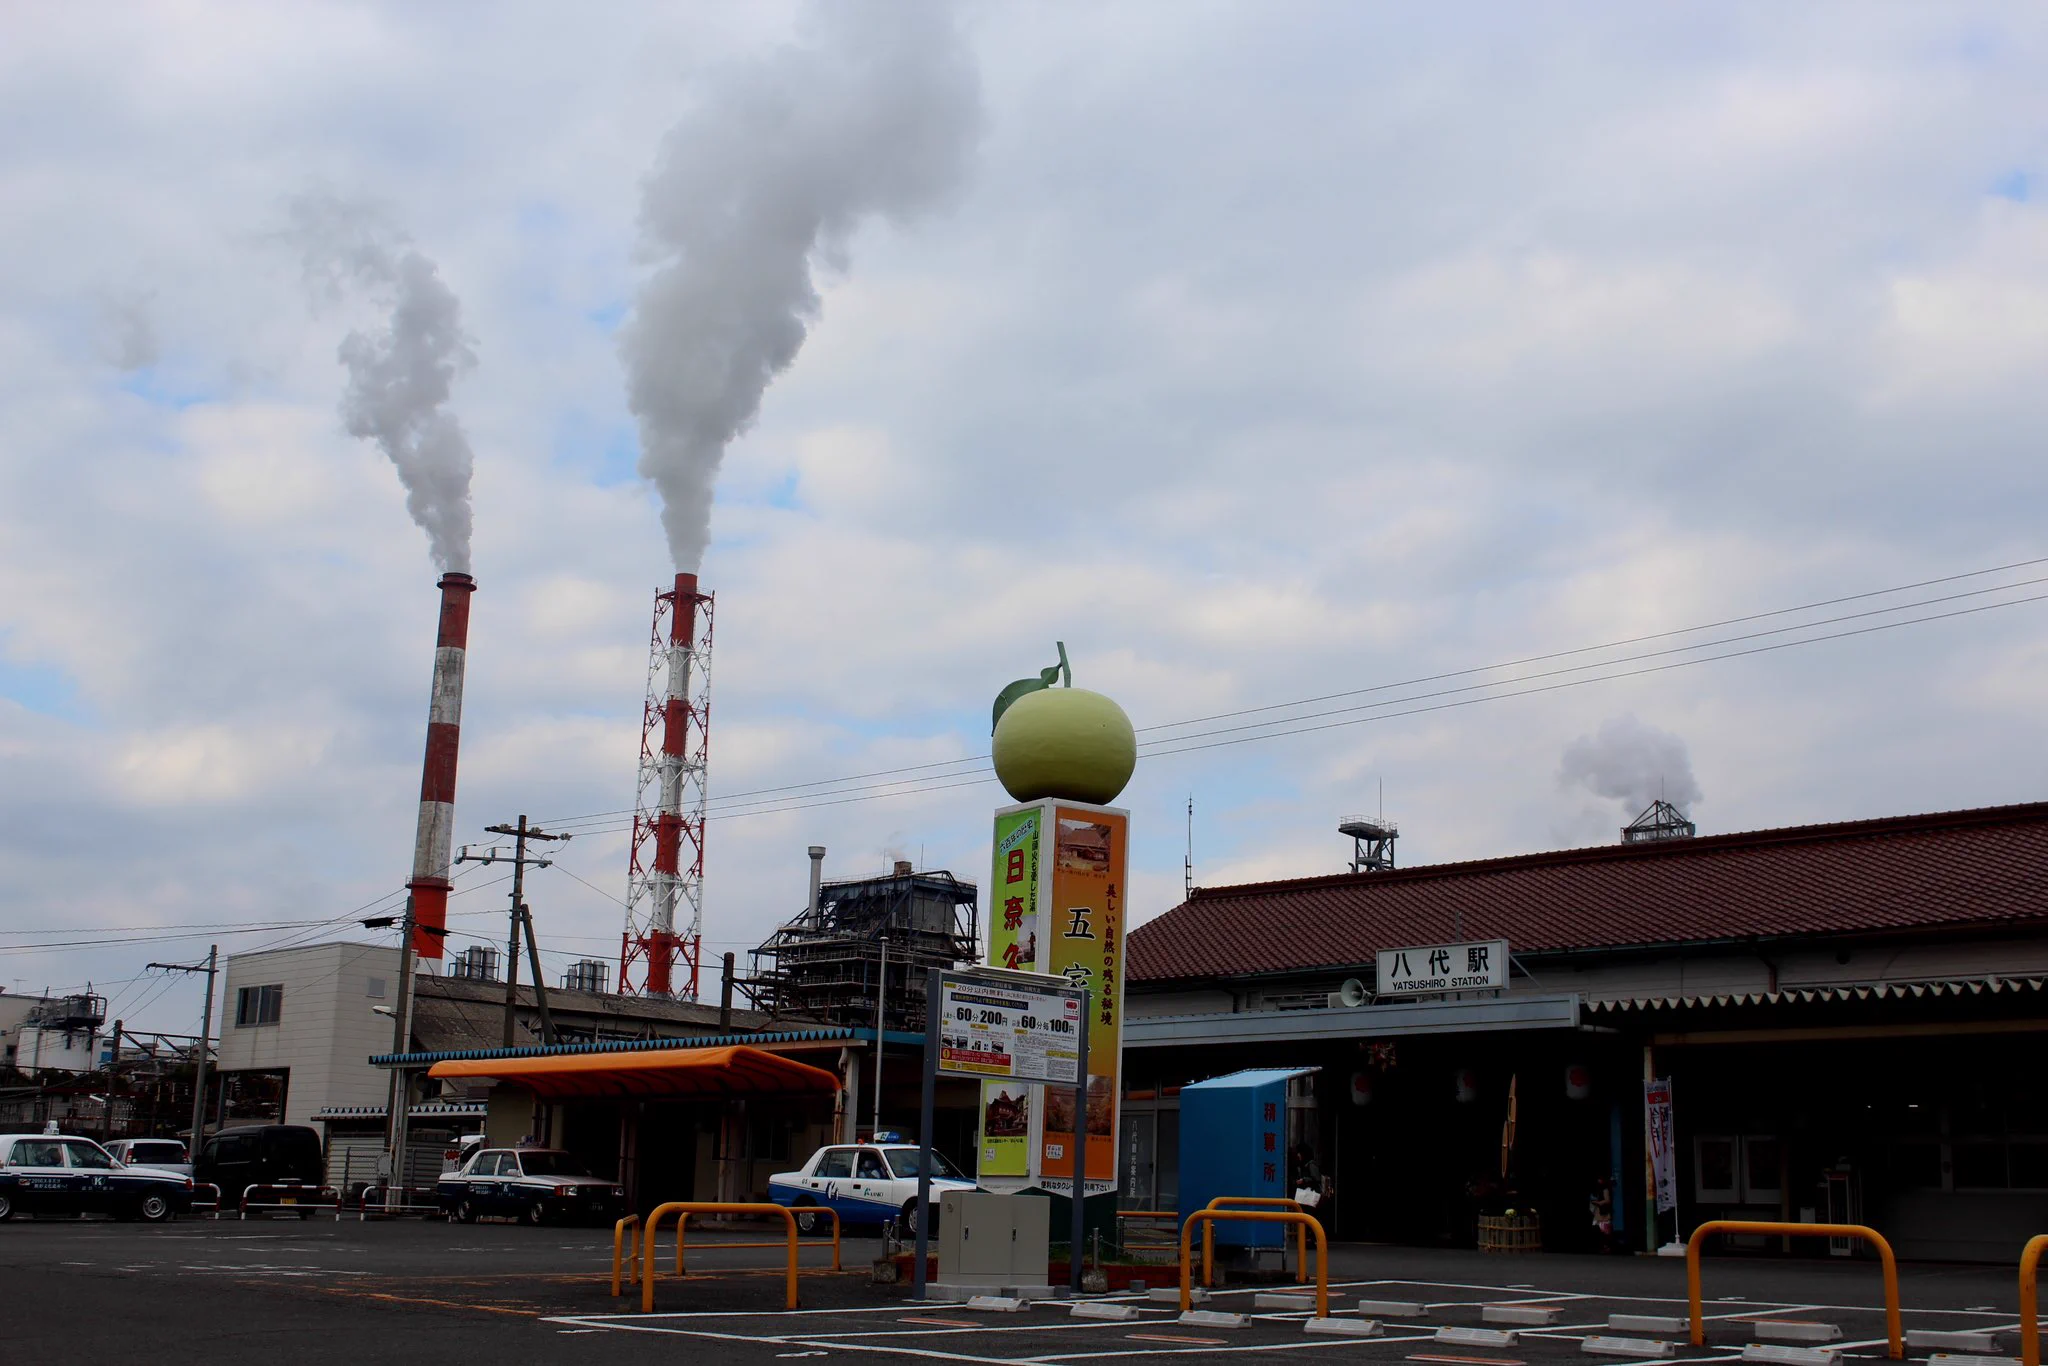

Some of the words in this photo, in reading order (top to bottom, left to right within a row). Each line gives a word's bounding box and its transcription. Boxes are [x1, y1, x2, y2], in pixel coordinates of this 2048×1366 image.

[1100, 883, 1118, 1026] 美しい自然の残る秘境
[1391, 946, 1489, 978] 八代駅
[1392, 978, 1446, 991] YATSUSHIRO
[1451, 975, 1489, 987] STATION
